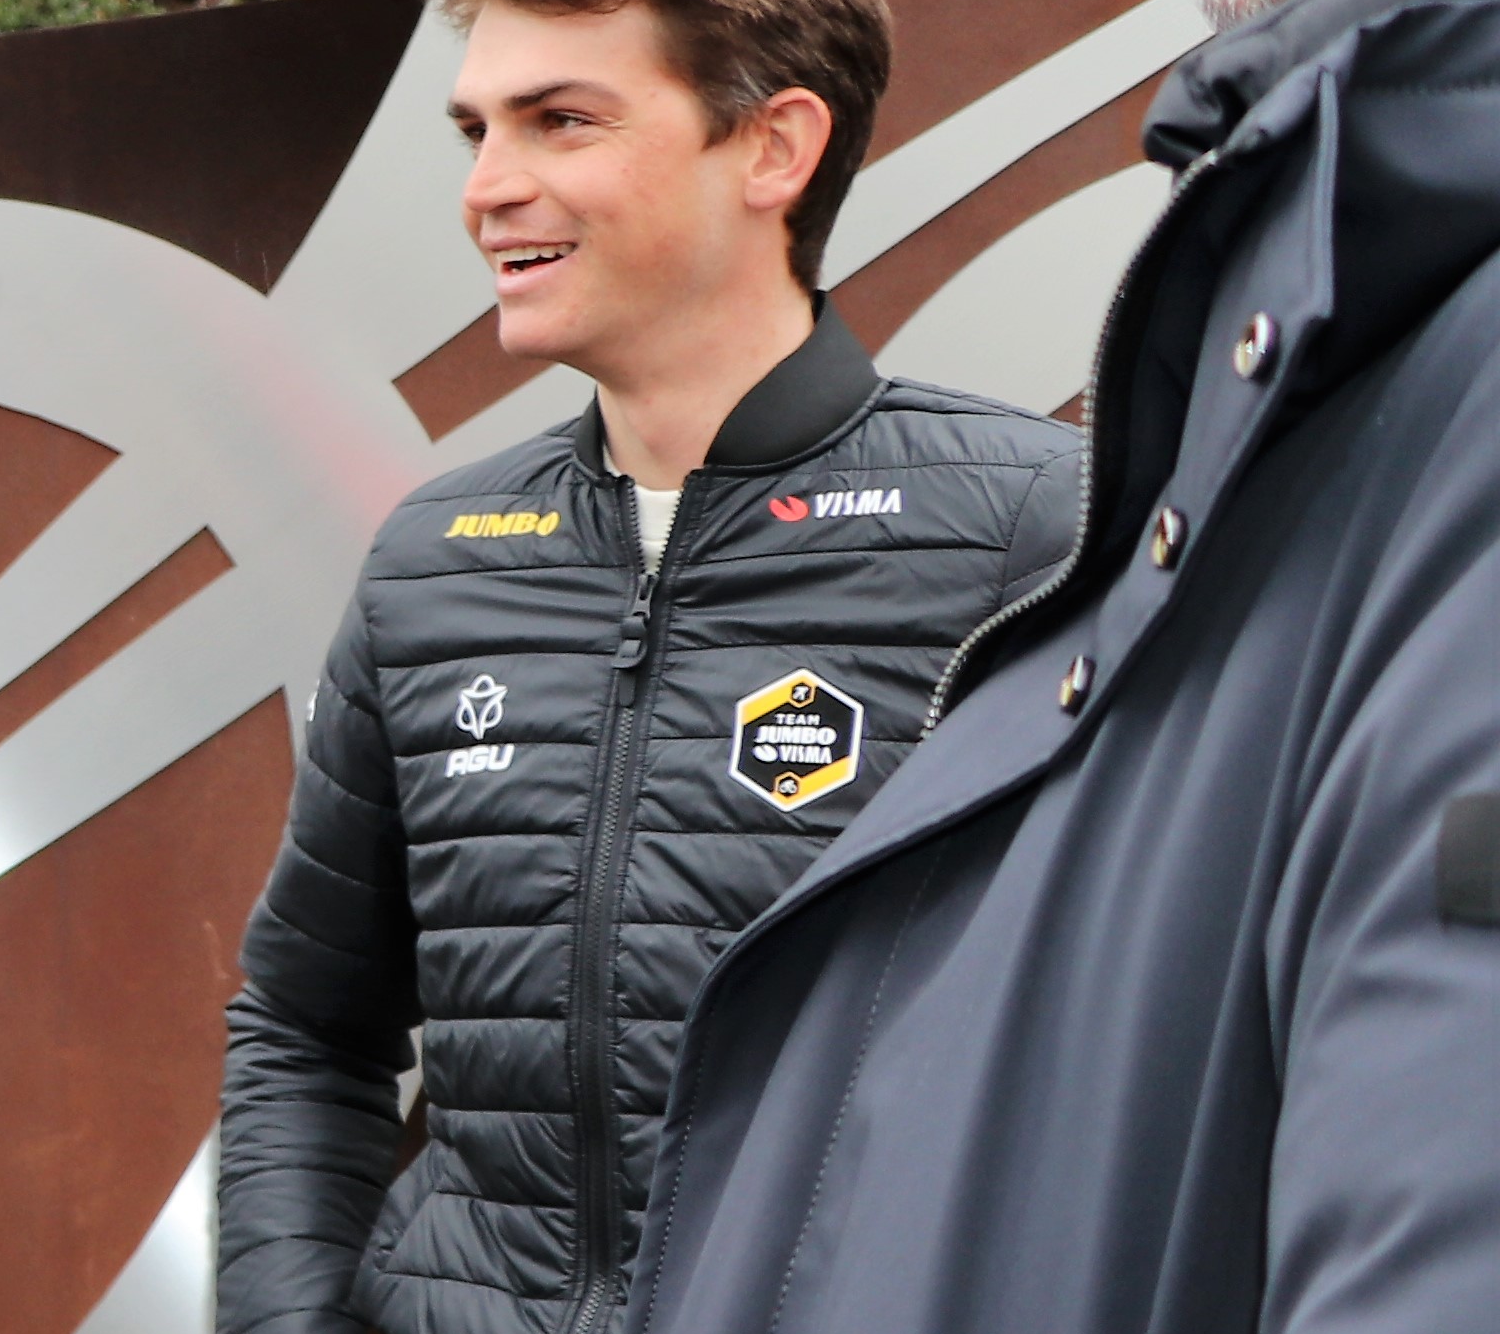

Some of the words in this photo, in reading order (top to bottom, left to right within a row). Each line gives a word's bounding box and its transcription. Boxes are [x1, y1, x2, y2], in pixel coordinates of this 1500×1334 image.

[814, 487, 901, 519] VISMA
[443, 510, 560, 539] JUMBO
[774, 712, 821, 726] TEAM
[753, 725, 838, 746] JUMBO
[444, 742, 516, 780] AGU
[779, 744, 833, 765] VISMA
